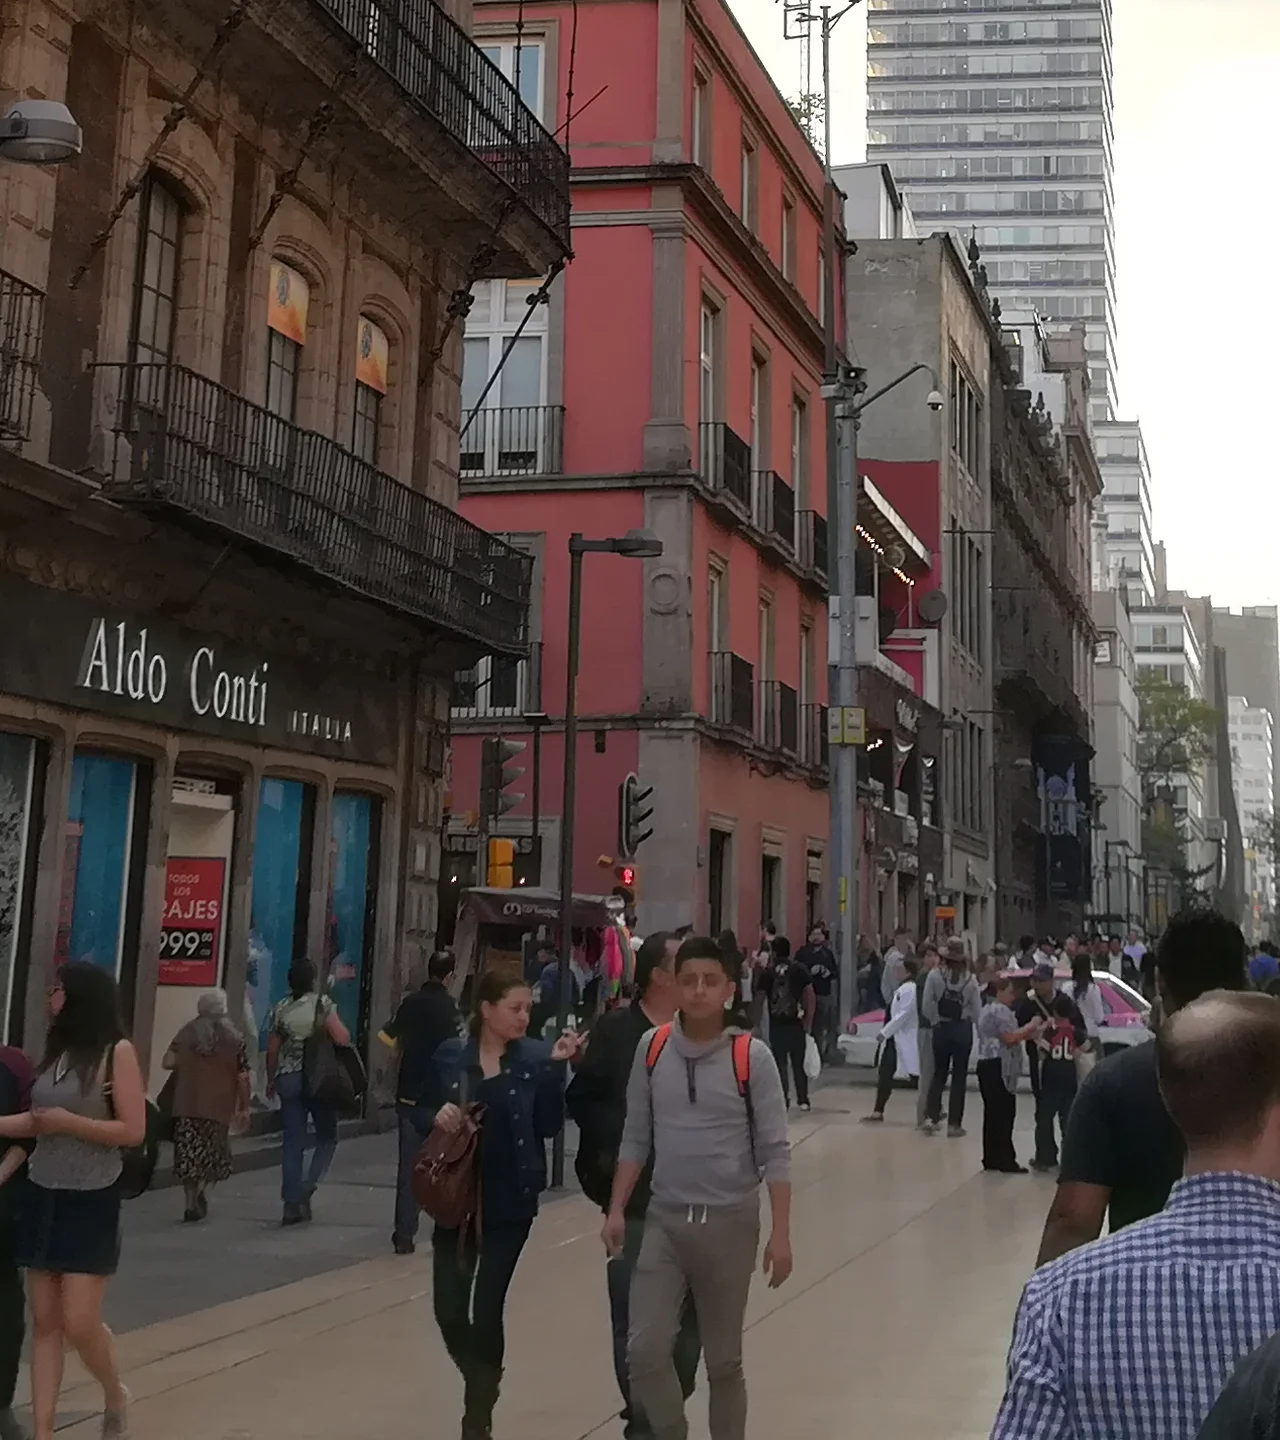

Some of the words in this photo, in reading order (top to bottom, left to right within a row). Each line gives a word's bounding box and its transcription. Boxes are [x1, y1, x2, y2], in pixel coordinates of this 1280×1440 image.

[82, 617, 166, 704] Aldo
[189, 647, 270, 726] Conti
[290, 709, 352, 742] ITALIA
[161, 899, 218, 919] RAJES
